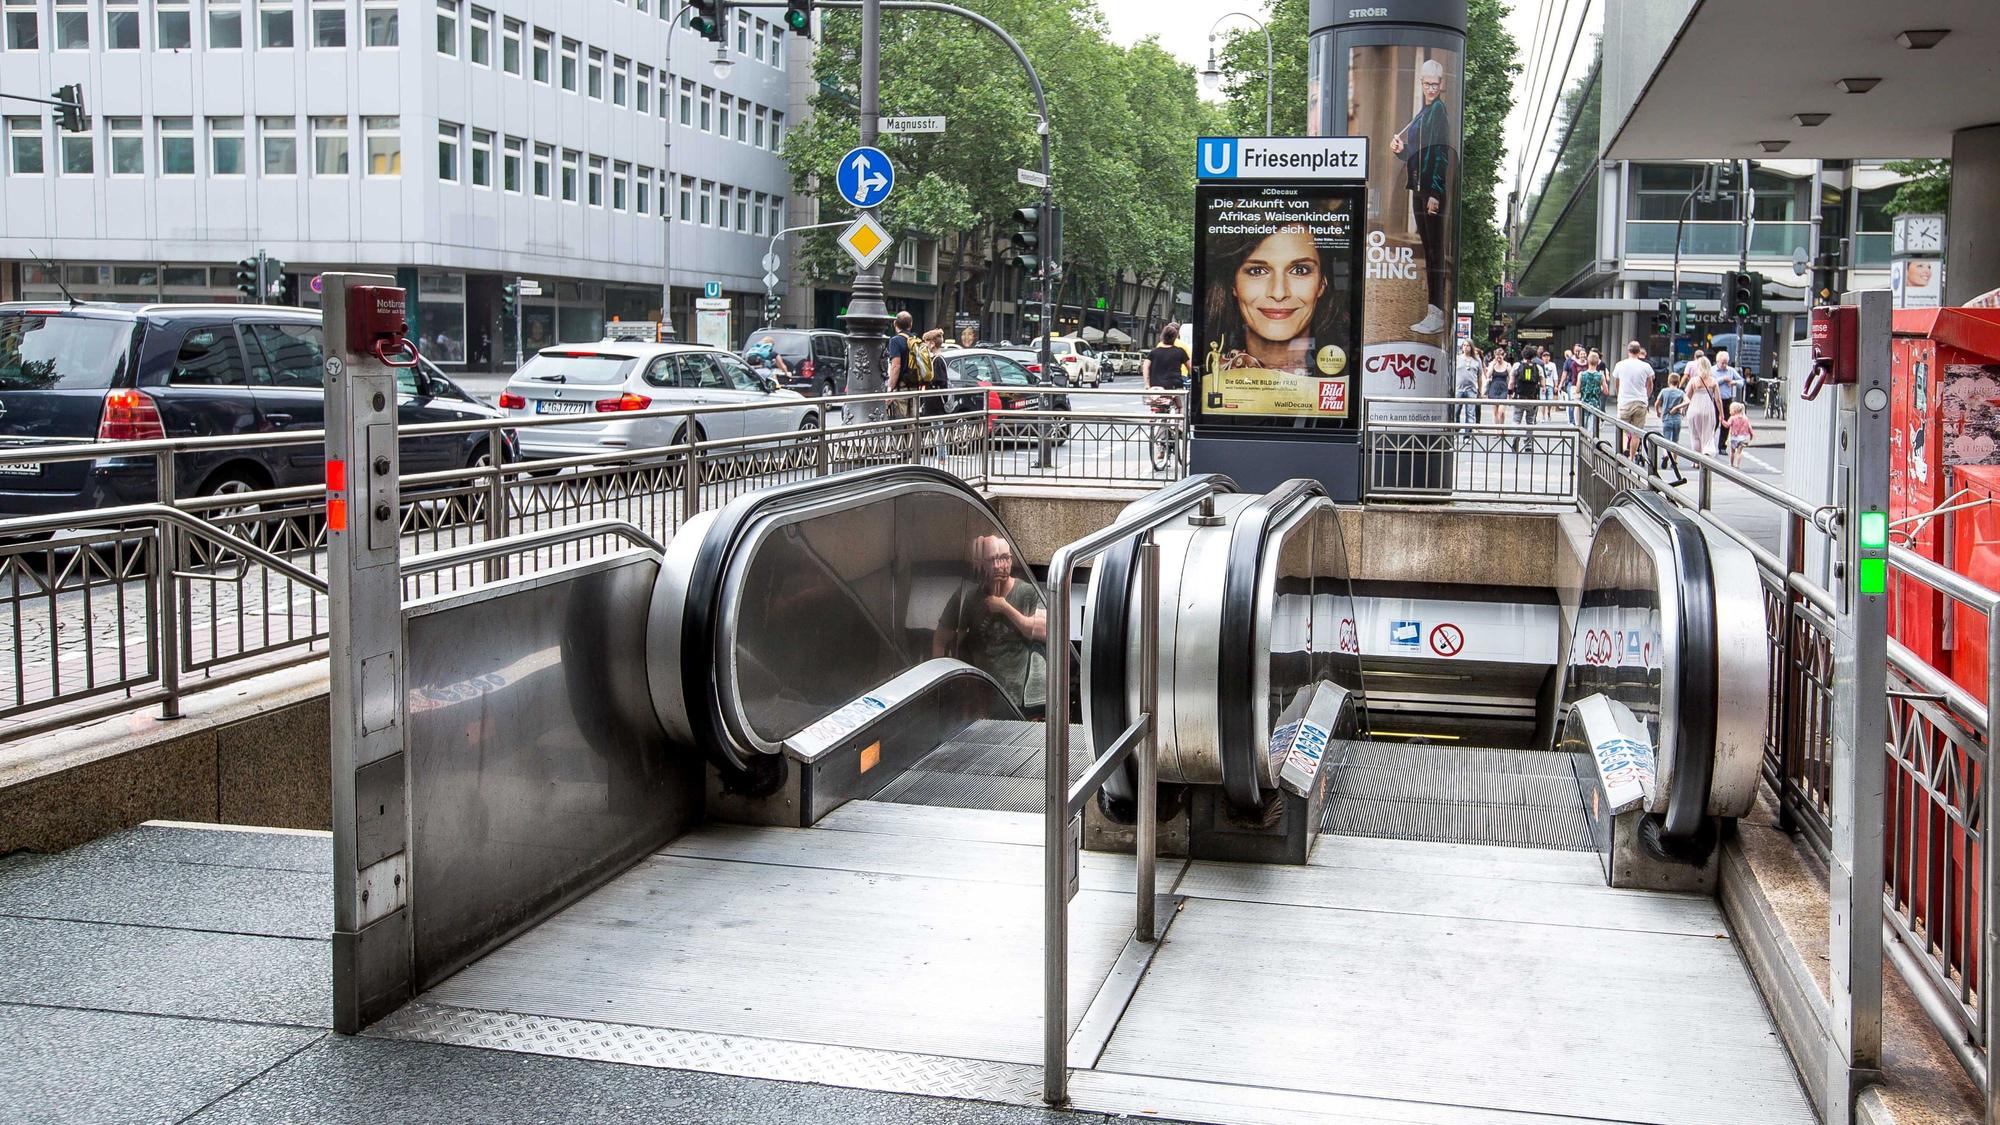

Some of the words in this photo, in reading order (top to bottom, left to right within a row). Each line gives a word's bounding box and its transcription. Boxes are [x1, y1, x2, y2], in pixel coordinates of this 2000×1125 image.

[886, 118, 938, 131] Magnusstr.
[1204, 143, 1231, 175] U
[1244, 148, 1359, 172] Friesenplatz
[1237, 199, 1285, 209] Zukunft
[1287, 200, 1310, 209] von
[1218, 211, 1261, 221] Afrikas
[1264, 211, 1350, 222] Waisenkindern
[1208, 224, 1277, 234] entscheidet
[1280, 224, 1305, 235] sich
[1366, 231, 1386, 247] O
[1366, 246, 1413, 263] OUR
[1366, 263, 1417, 280] HING
[707, 283, 718, 296] U
[1365, 353, 1438, 375] CAMEL
[1320, 383, 1344, 396] Bild
[1274, 401, 1313, 409] WallDecaux
[1320, 396, 1344, 410] Frau
[1370, 413, 1388, 421] chen
[1390, 413, 1408, 421] kann
[1409, 413, 1431, 422] tödlich
